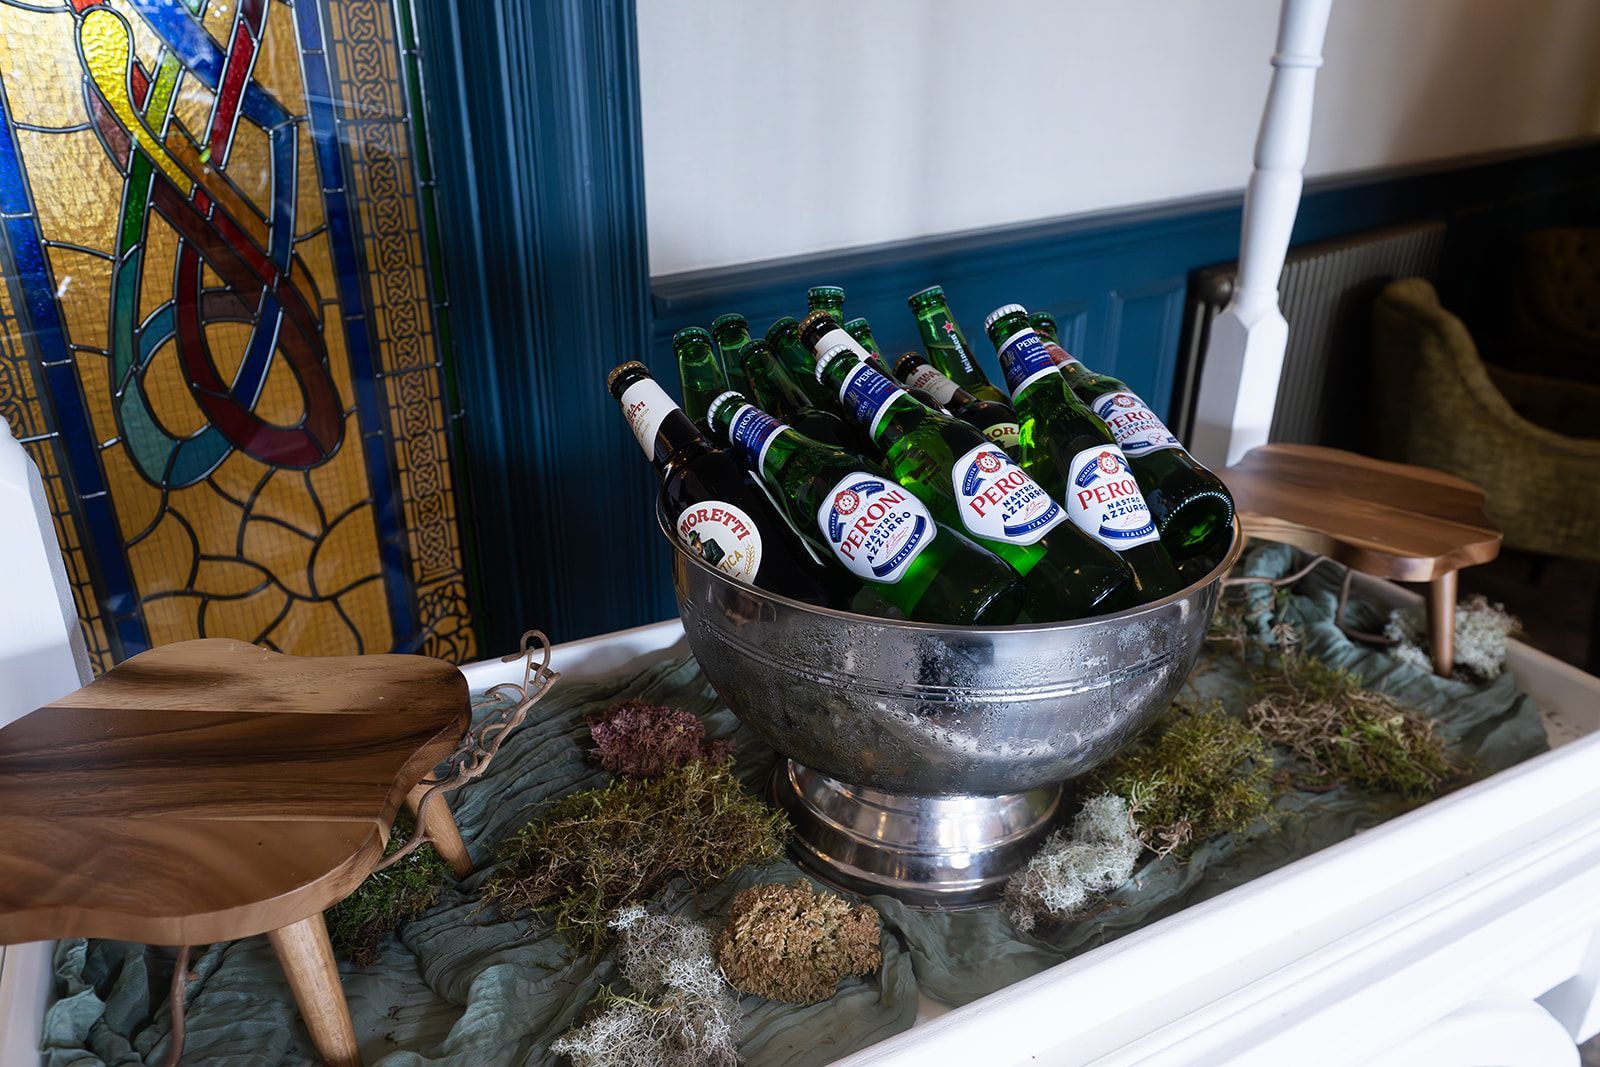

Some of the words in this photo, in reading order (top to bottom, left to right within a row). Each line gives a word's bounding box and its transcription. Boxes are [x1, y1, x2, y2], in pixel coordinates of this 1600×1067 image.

[951, 333, 973, 373] Heineken
[1002, 484, 1034, 508] NASTRO
[1107, 497, 1141, 510] NASTRO
[681, 508, 750, 541] MORETTI
[840, 490, 907, 561] PERONI
[865, 512, 896, 549] NASTRO
[866, 511, 911, 563] AZZURRO
[890, 533, 920, 566] ITALIANA
